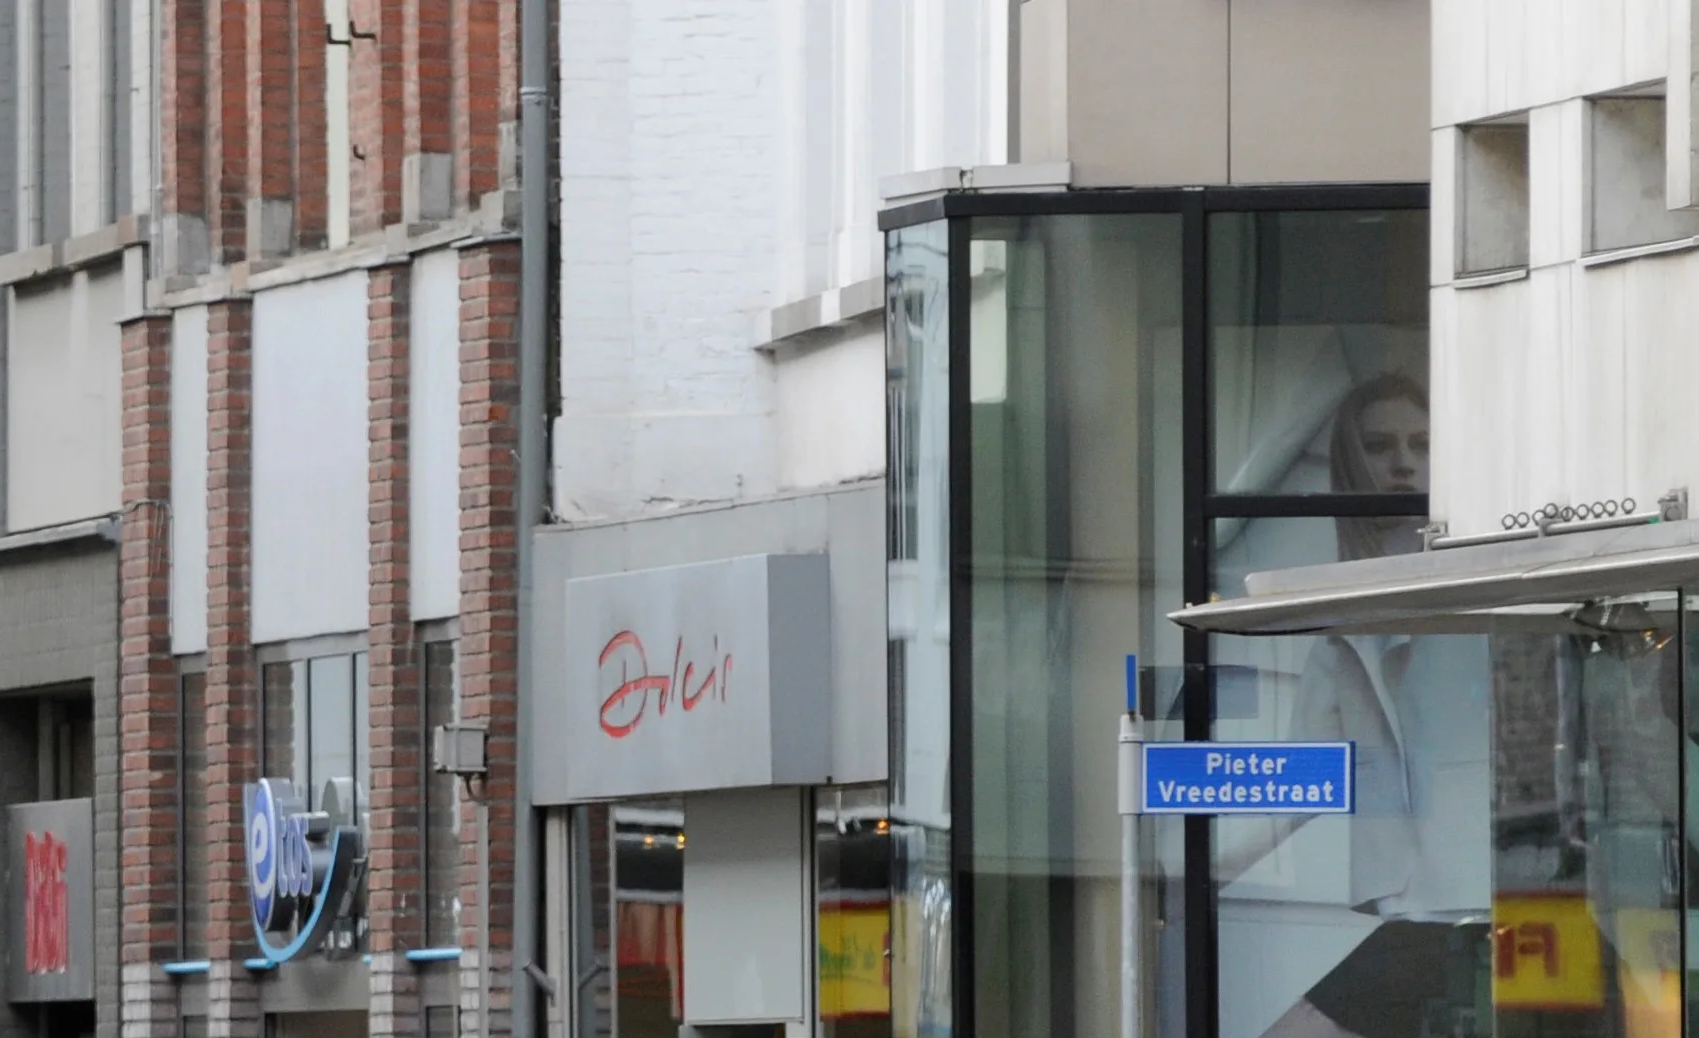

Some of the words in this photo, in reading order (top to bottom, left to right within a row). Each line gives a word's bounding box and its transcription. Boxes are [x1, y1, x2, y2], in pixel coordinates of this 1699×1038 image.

[599, 630, 733, 739] Dolcis
[1158, 780, 1334, 803] Vreedestraat
[1206, 752, 1287, 775] Pieter
[251, 797, 313, 899] etos
